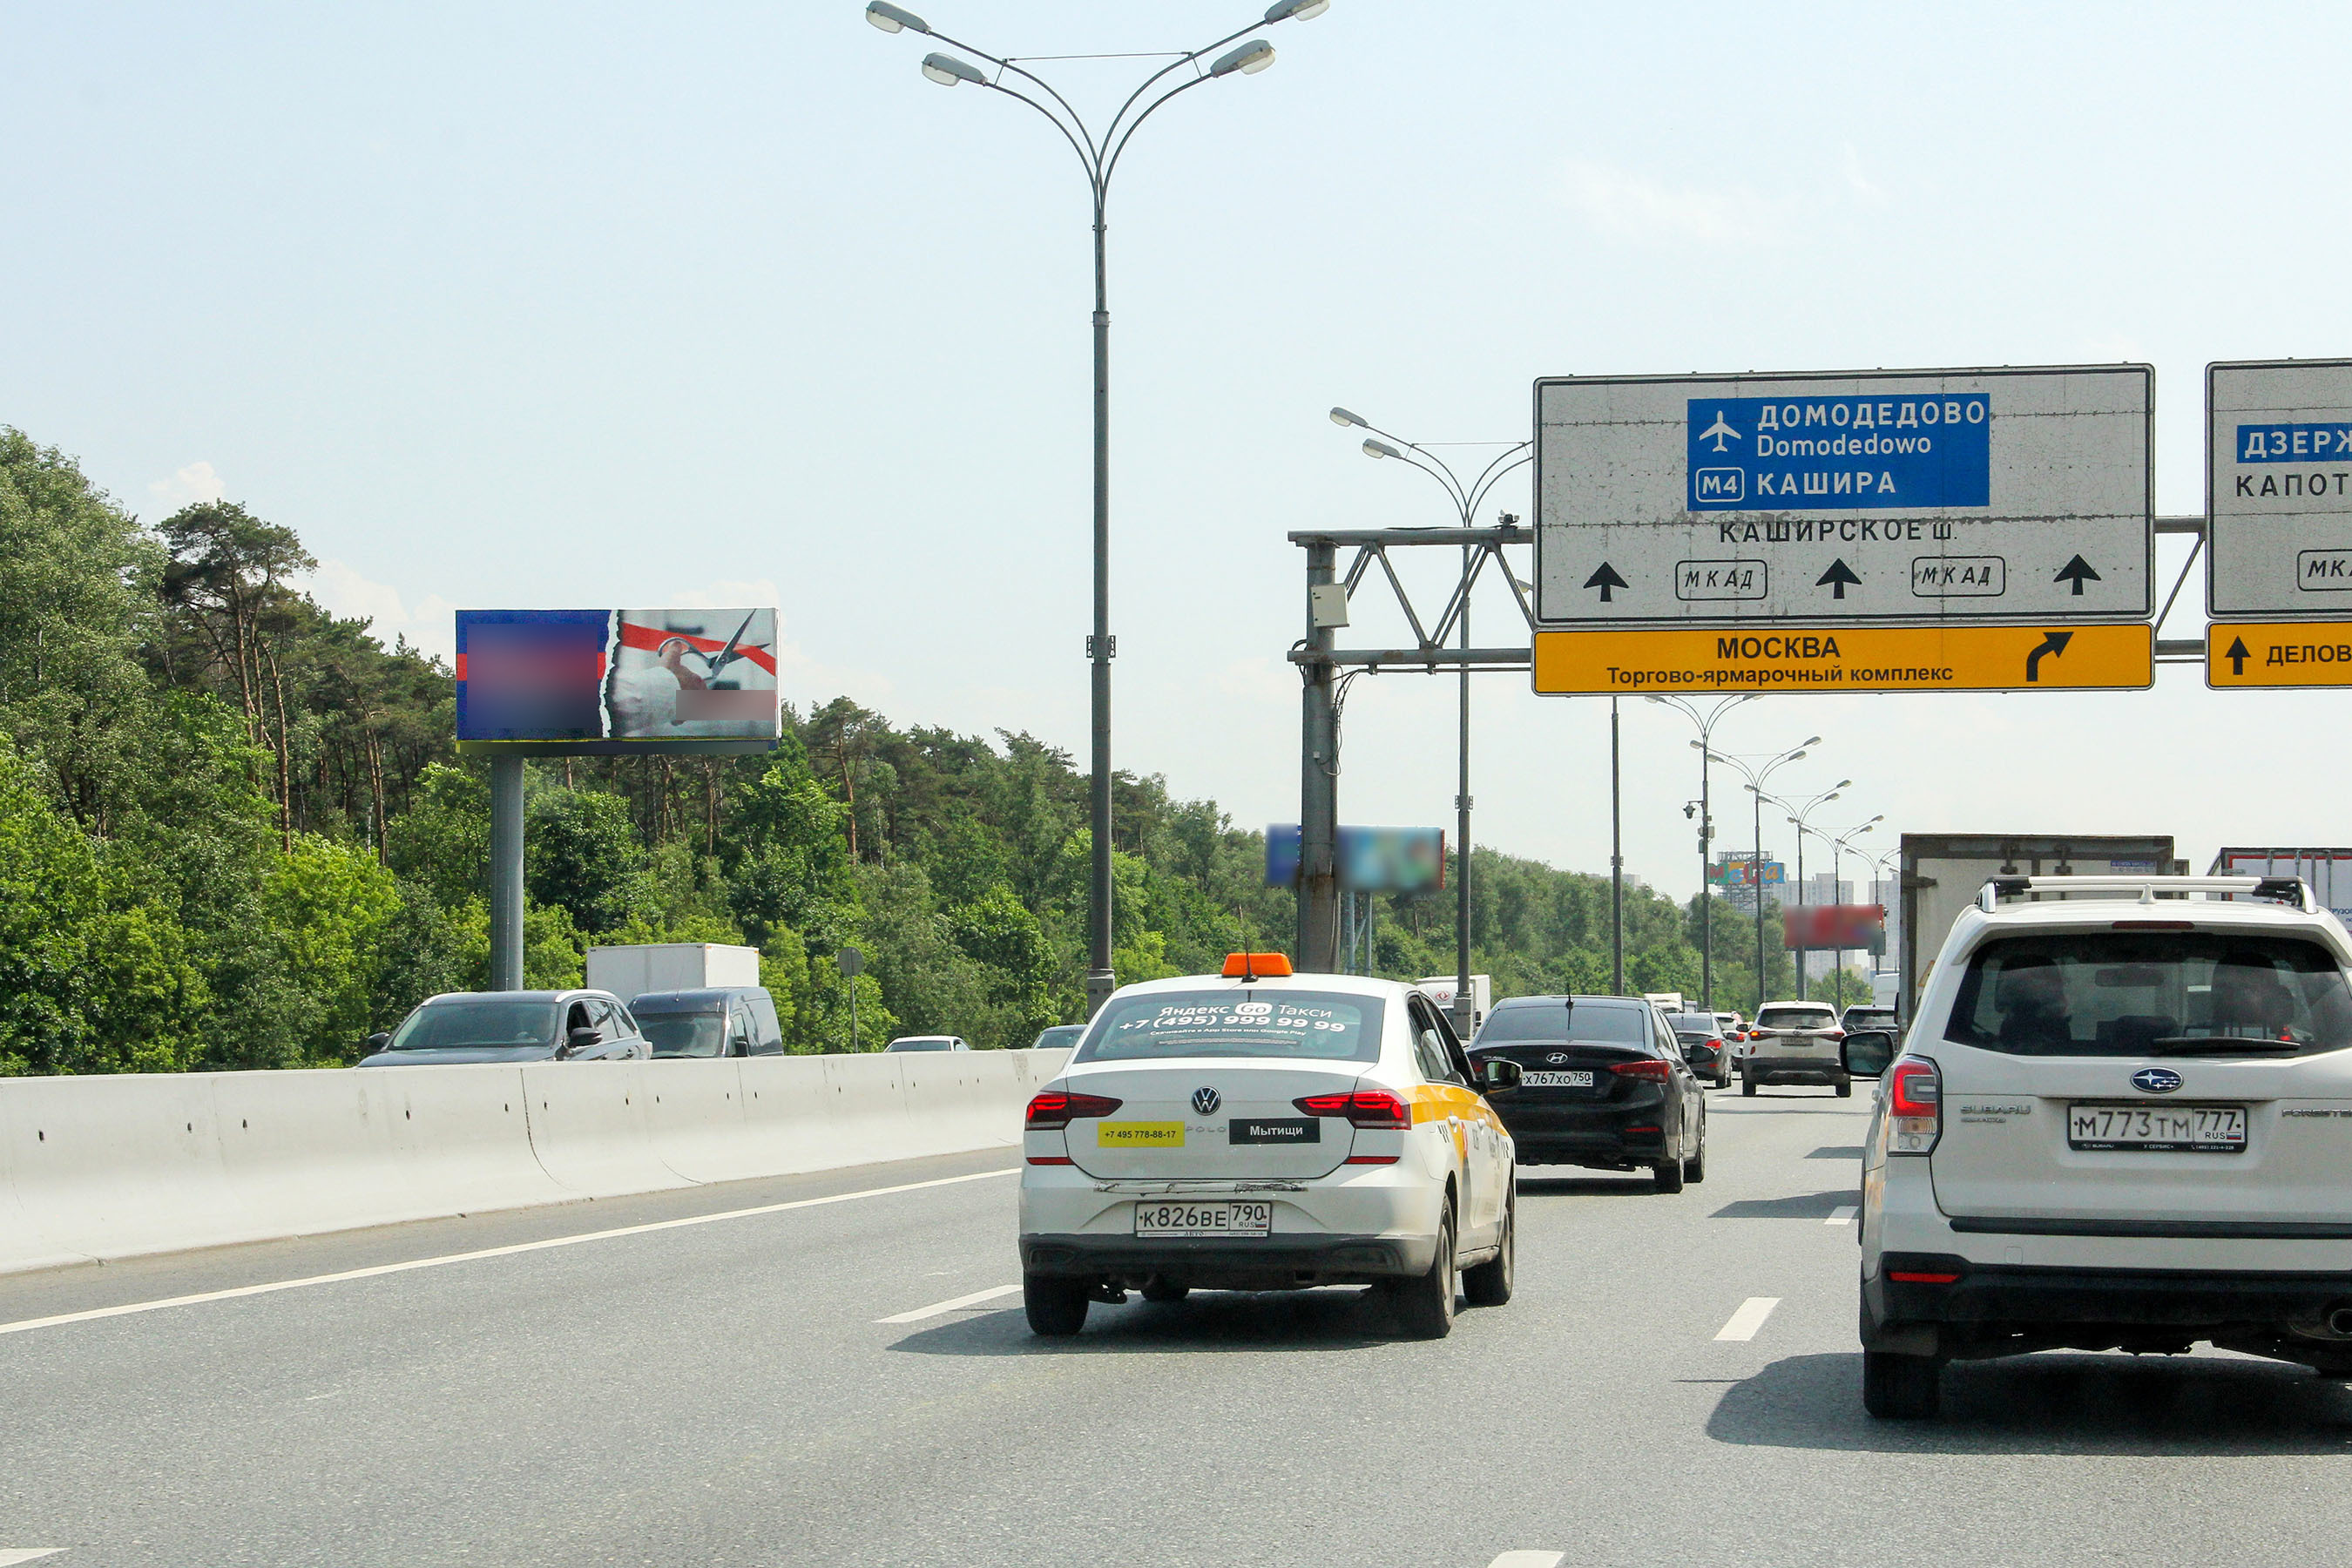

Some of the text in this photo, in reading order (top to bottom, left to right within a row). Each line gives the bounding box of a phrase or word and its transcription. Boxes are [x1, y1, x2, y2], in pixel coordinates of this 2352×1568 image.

[1757, 401, 1984, 431] ДОМОДЕДОВО
[1757, 433, 1932, 457] Domodedowo
[1757, 471, 1896, 496] КАШИРА
[1720, 518, 1922, 544] КАШИРСКОЕ
[1684, 569, 1755, 589] МКАД
[1921, 565, 1992, 587] МКАД
[2308, 560, 2352, 578] МК
[1717, 637, 1841, 659] МОСКВА
[2267, 645, 2352, 666] ДЕЛОВ
[1606, 666, 1954, 686] Торгово-ярмарочный комплекс
[1159, 1006, 1230, 1017] Яндекс
[1279, 1004, 1332, 1018] Такси
[1119, 1015, 1346, 1032] +7 (495) 999 99 99
[1572, 1072, 1589, 1082] 750
[1960, 1105, 2031, 1115] SUBARU
[1250, 1125, 1303, 1136] Мытищи
[2195, 1111, 2237, 1131] 777
[1233, 1206, 1264, 1220] 790
